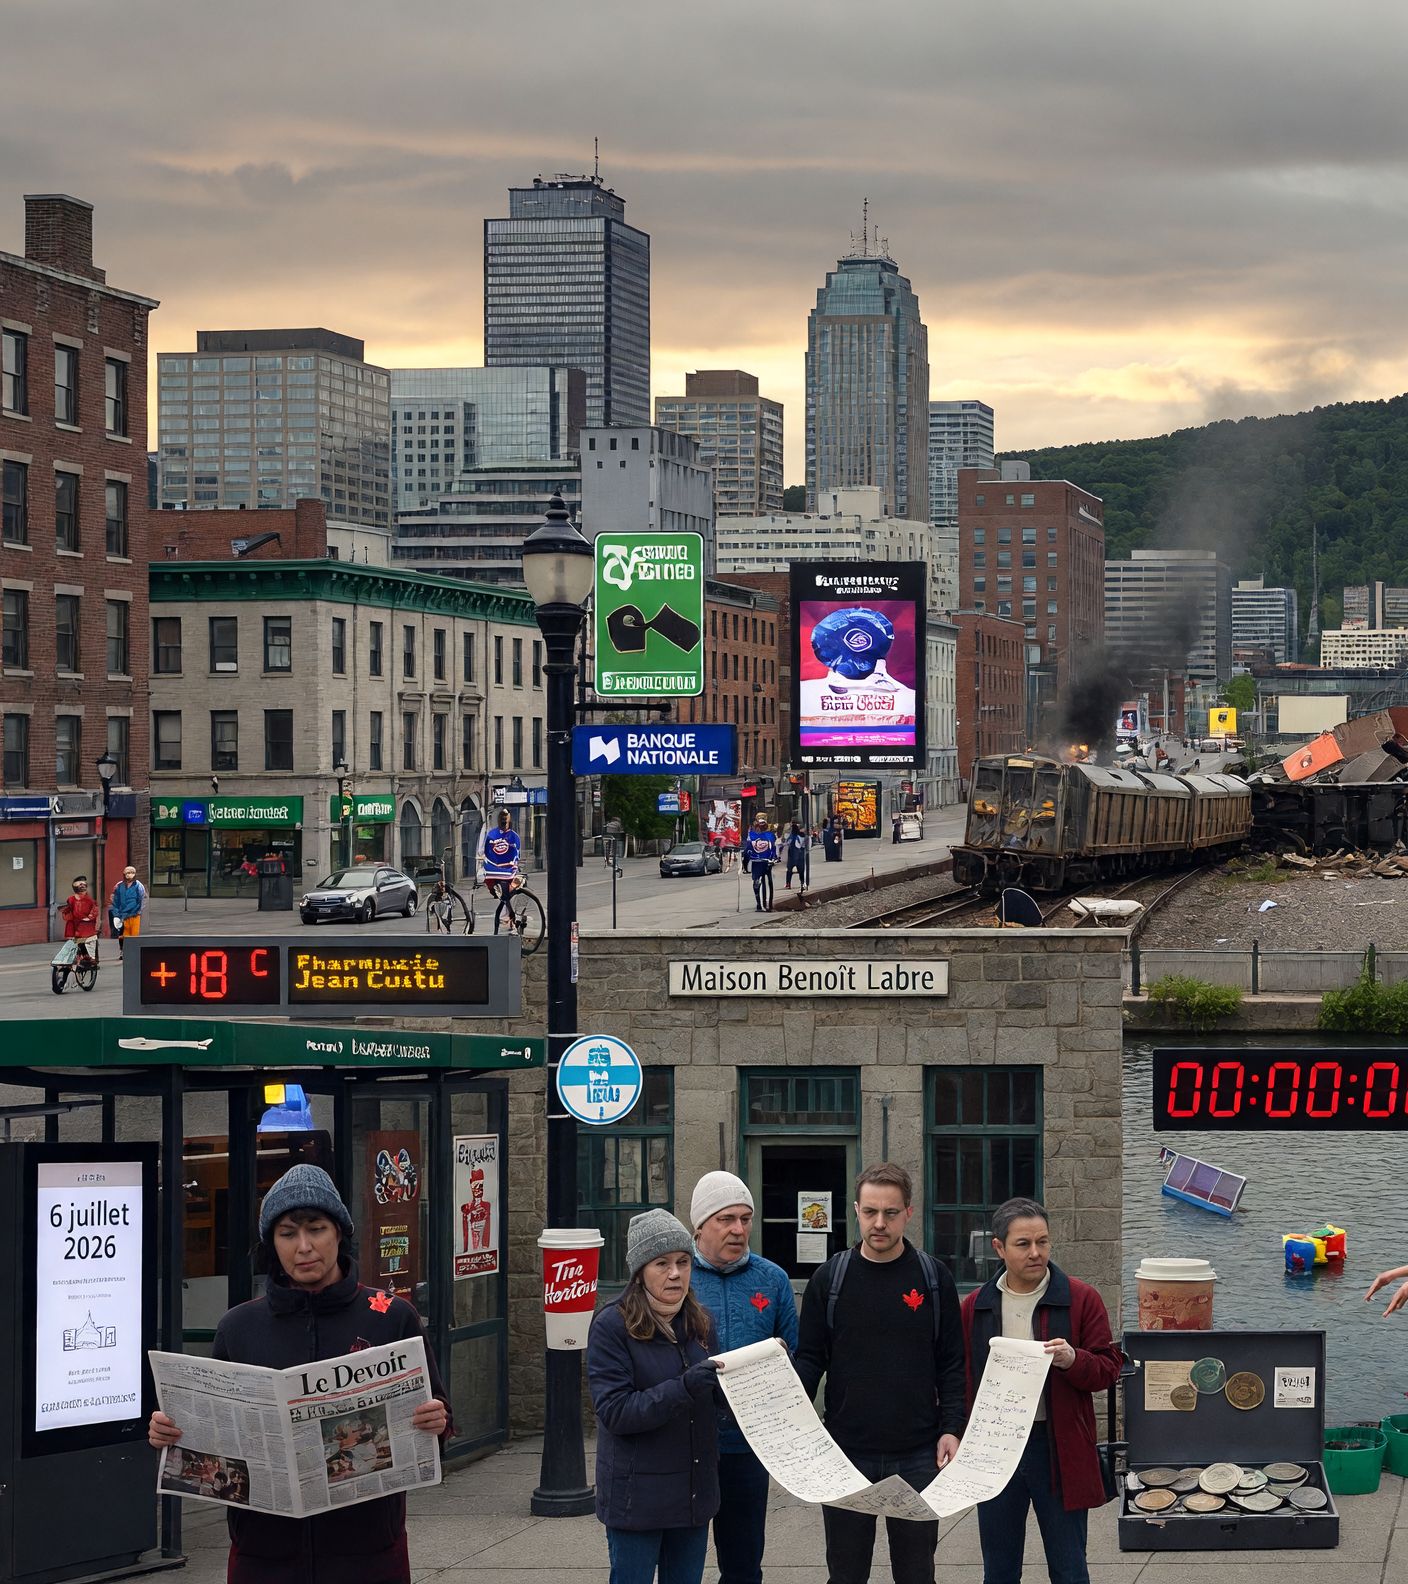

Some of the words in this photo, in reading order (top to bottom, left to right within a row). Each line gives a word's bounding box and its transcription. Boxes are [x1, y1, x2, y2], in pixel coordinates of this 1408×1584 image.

[627, 733, 696, 749] BANQUE
[627, 750, 719, 765] NATIONALE
[295, 970, 359, 989] Jean
[681, 964, 767, 991] Maison
[778, 964, 856, 991] Benoît
[867, 963, 934, 991] Labre
[50, 1203, 63, 1228] 6
[67, 1199, 130, 1234] juillet
[63, 1234, 116, 1260] 2026
[299, 1371, 330, 1397] Le
[331, 1350, 408, 1389] Devoir
